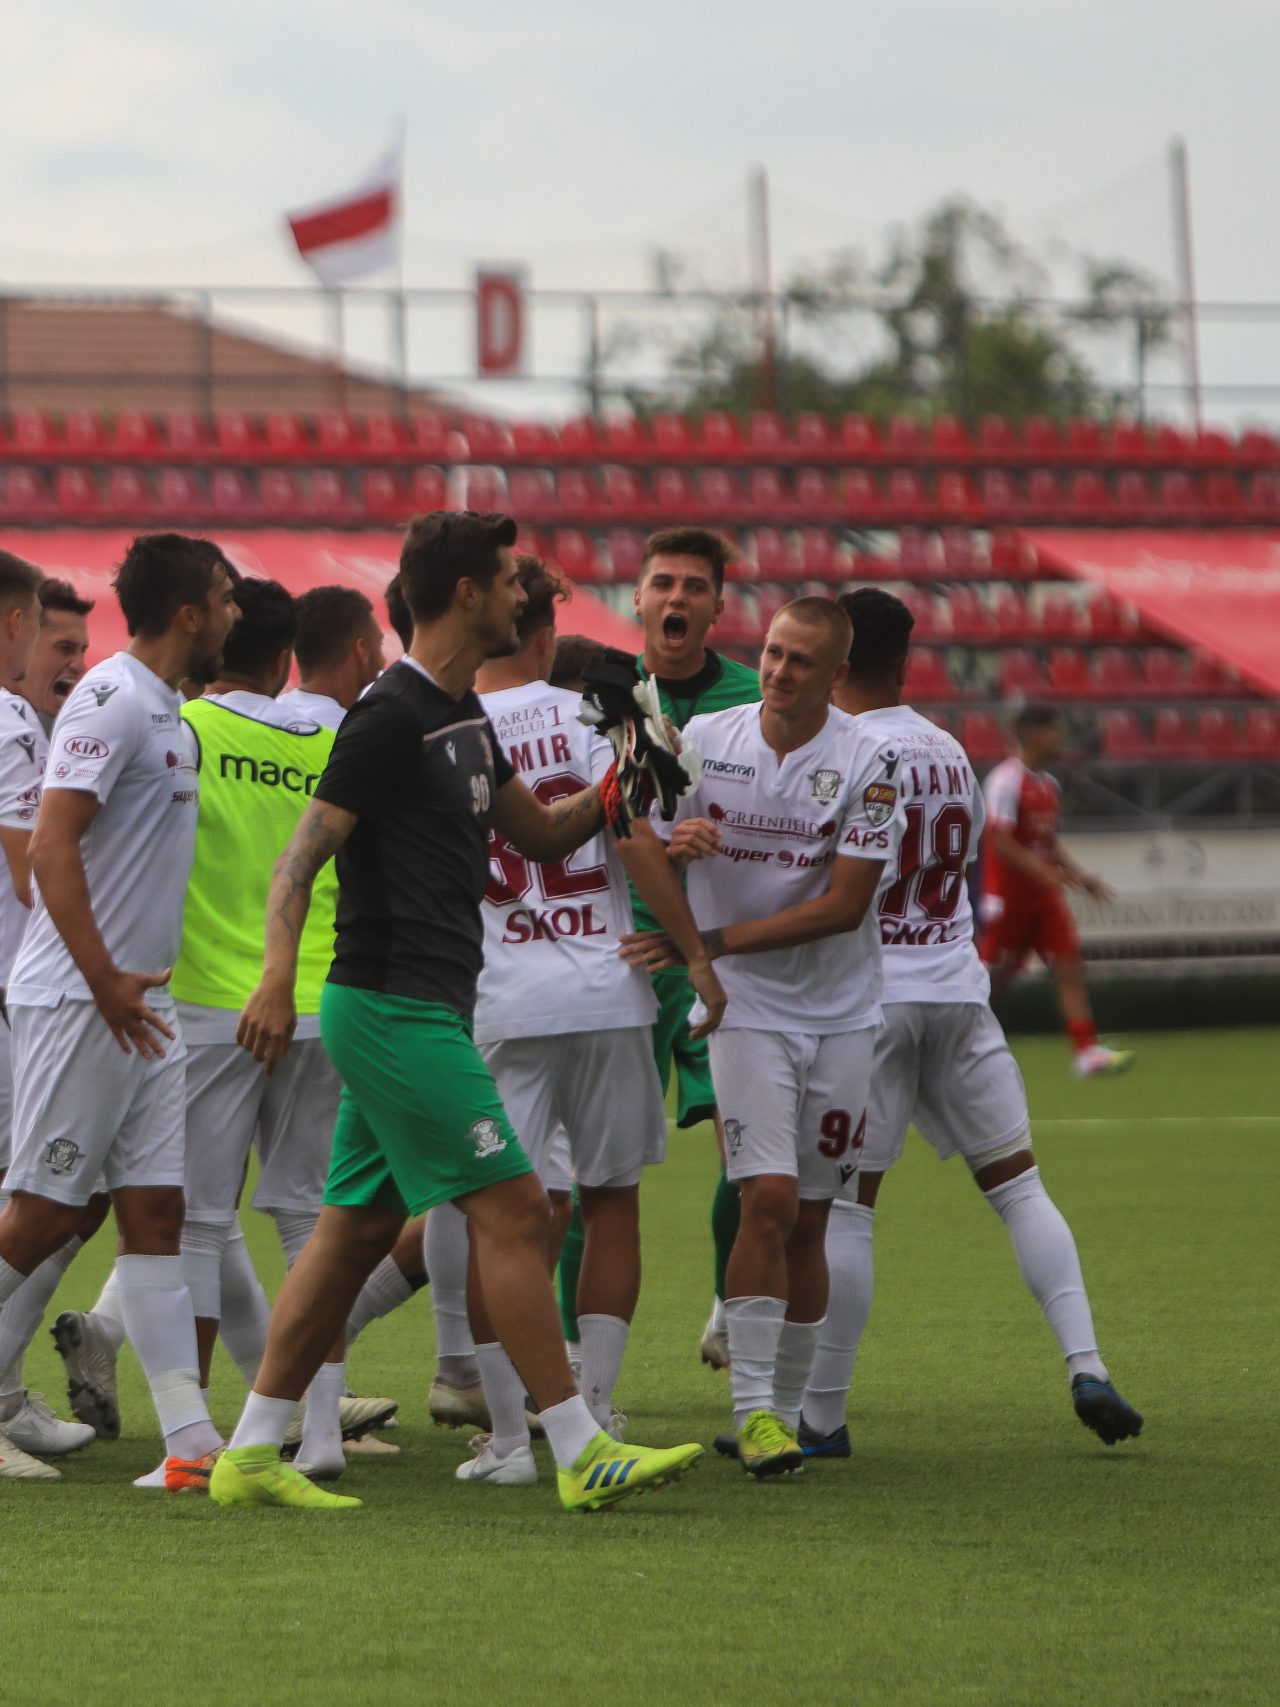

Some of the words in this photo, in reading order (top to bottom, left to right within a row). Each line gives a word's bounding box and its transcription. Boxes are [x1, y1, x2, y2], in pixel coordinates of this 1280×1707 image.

[477, 271, 523, 377] D
[492, 707, 544, 727] ARIA
[499, 720, 546, 740] RULUI
[546, 704, 565, 727] 1
[70, 739, 101, 757] KIA
[509, 732, 573, 774] MIR
[220, 752, 322, 796] macr
[702, 758, 756, 778] macron
[470, 773, 491, 816] 90
[723, 809, 821, 836] GREENFIELD
[843, 827, 889, 848] APS
[879, 801, 974, 920] 18
[502, 902, 608, 944] SKOL
